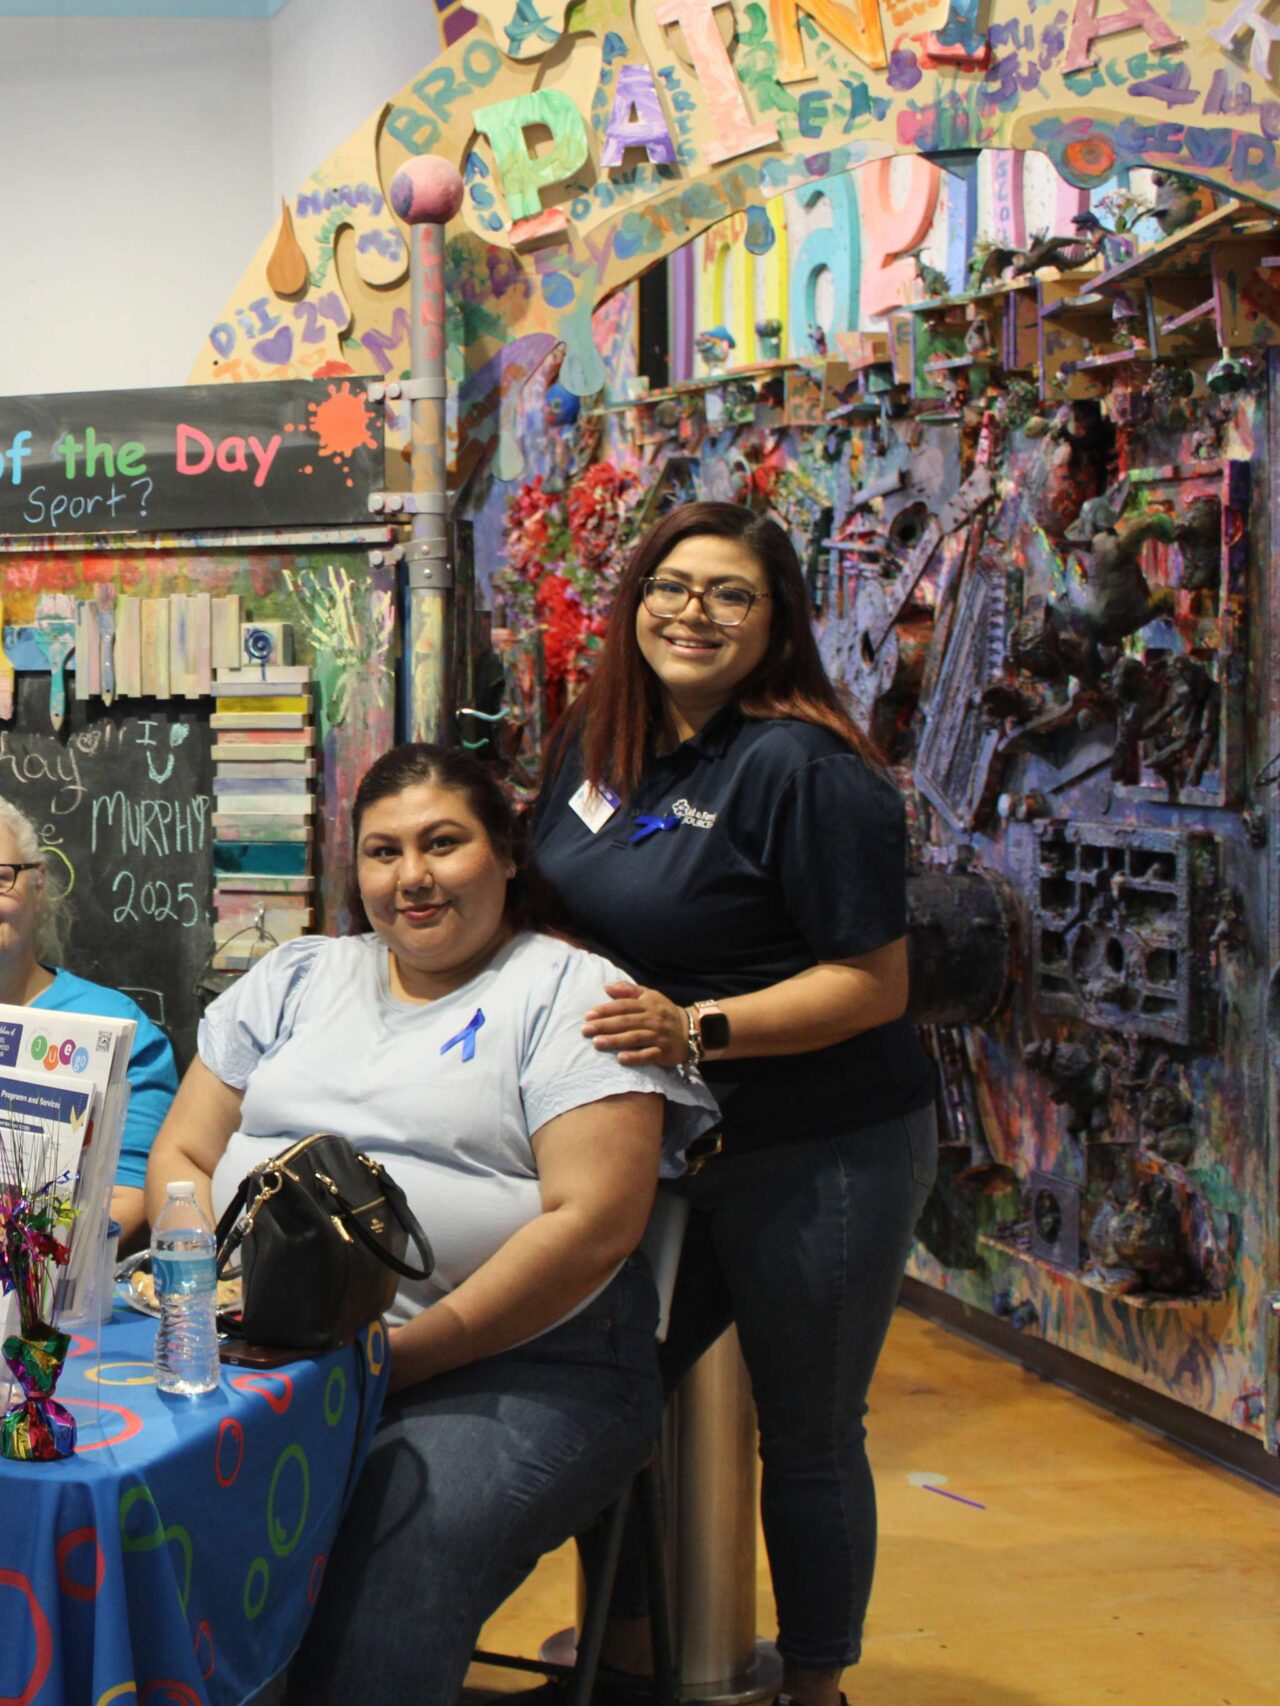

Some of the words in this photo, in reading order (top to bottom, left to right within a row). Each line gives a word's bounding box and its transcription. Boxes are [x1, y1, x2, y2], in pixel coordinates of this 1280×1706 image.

[58, 427, 146, 479] the
[175, 422, 283, 487] Day
[135, 720, 159, 746] I
[91, 790, 212, 858] MURPHY
[0, 1089, 27, 1104] Programs
[27, 1095, 40, 1105] and
[39, 1097, 61, 1109] Services
